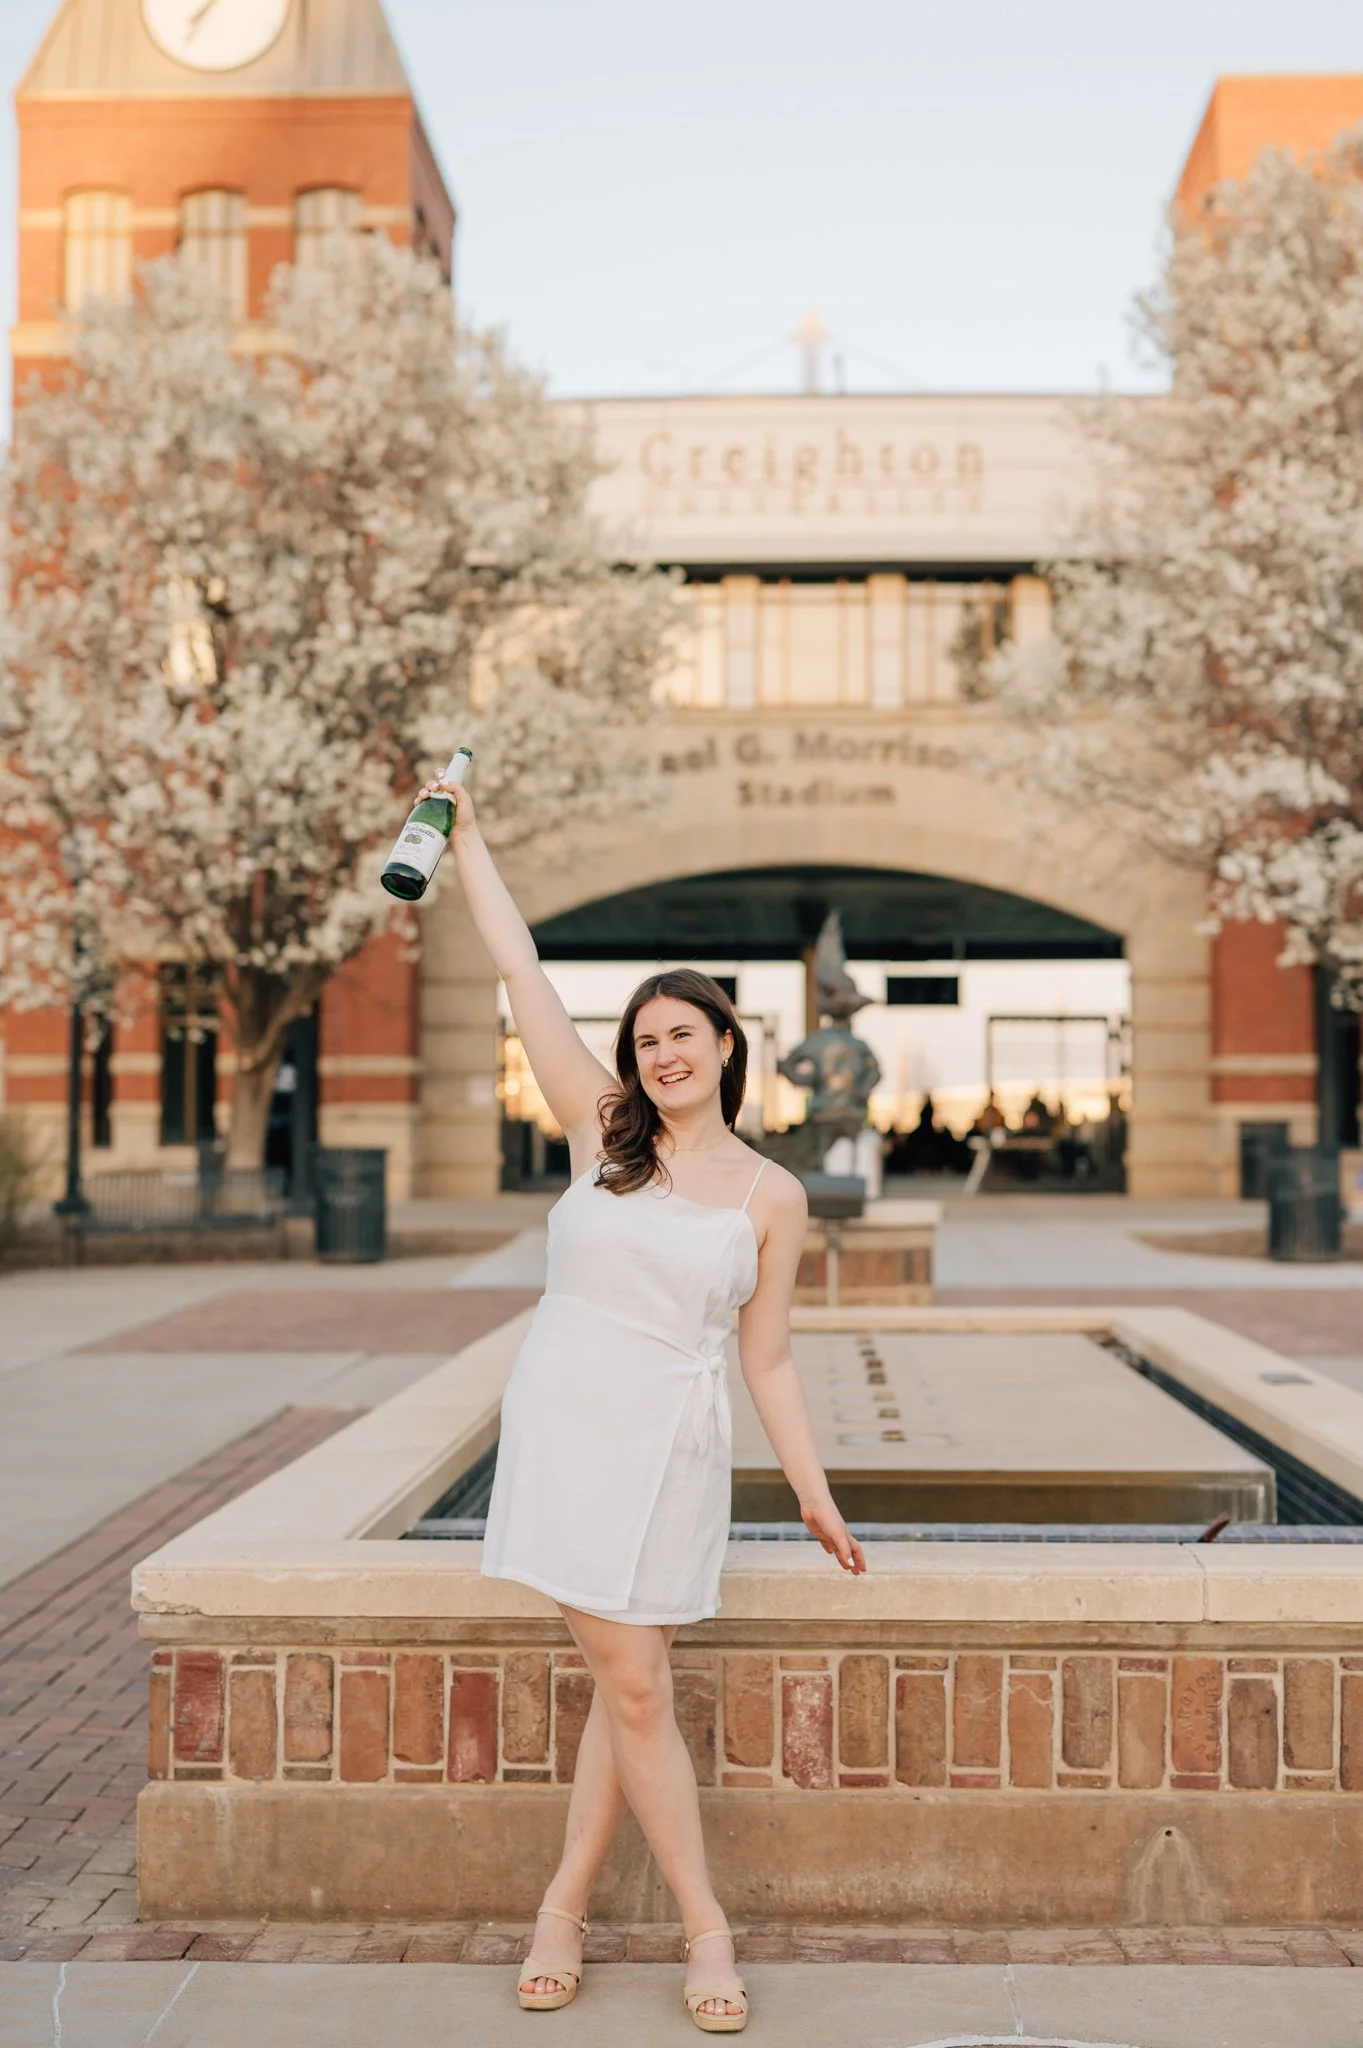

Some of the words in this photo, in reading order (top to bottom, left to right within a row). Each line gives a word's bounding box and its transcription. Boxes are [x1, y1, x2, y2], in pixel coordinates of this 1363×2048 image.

[639, 425, 985, 490] Creighton
[793, 731, 960, 769] Morriso
[737, 777, 896, 806] Stadium
